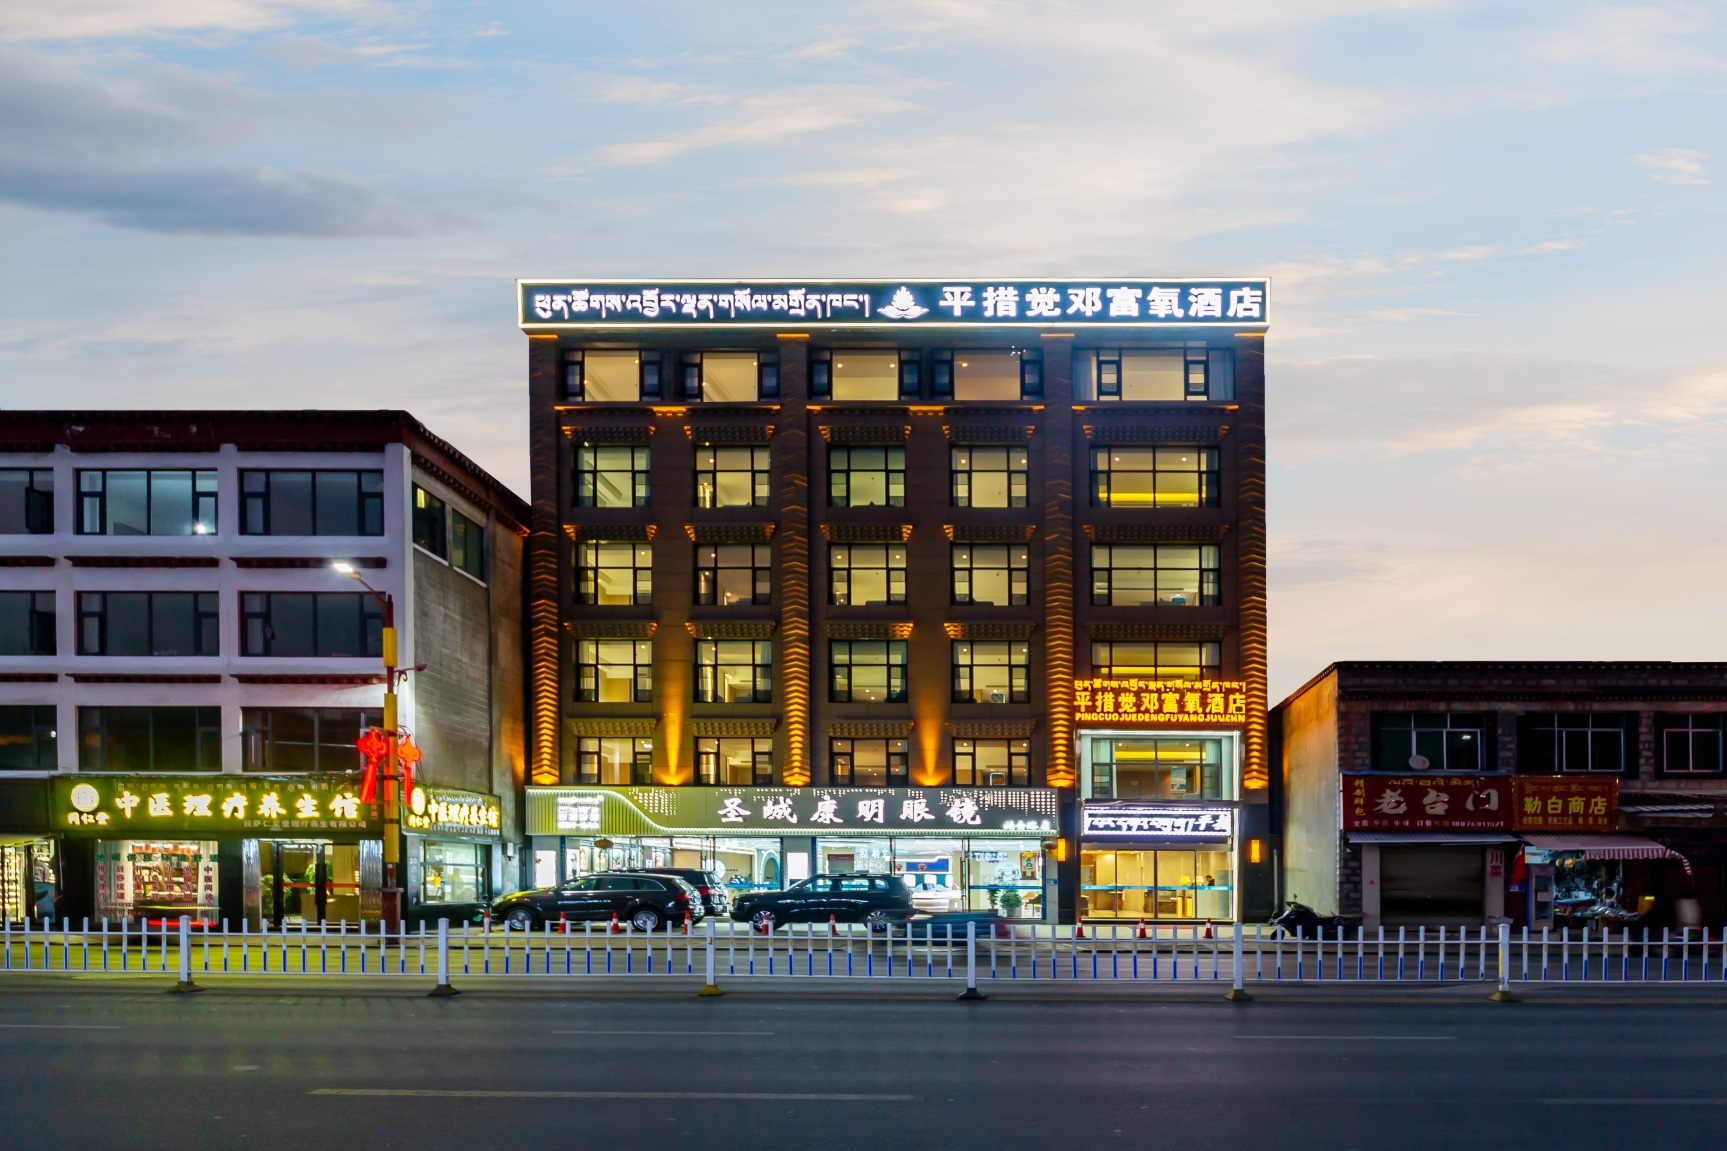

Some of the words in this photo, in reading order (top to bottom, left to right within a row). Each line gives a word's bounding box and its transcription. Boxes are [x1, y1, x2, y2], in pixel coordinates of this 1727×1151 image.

[939, 286, 1263, 318] 平措觉邓富氧酒店
[1073, 691, 1246, 714] 平措觉邓富氧酒店
[115, 791, 361, 819] 中医理疗养生馆
[717, 796, 983, 826] 圣城康明眼镜
[1372, 788, 1499, 815] 老台门
[1523, 796, 1608, 815] 勒白商店
[1490, 851, 1502, 878] 川菜
